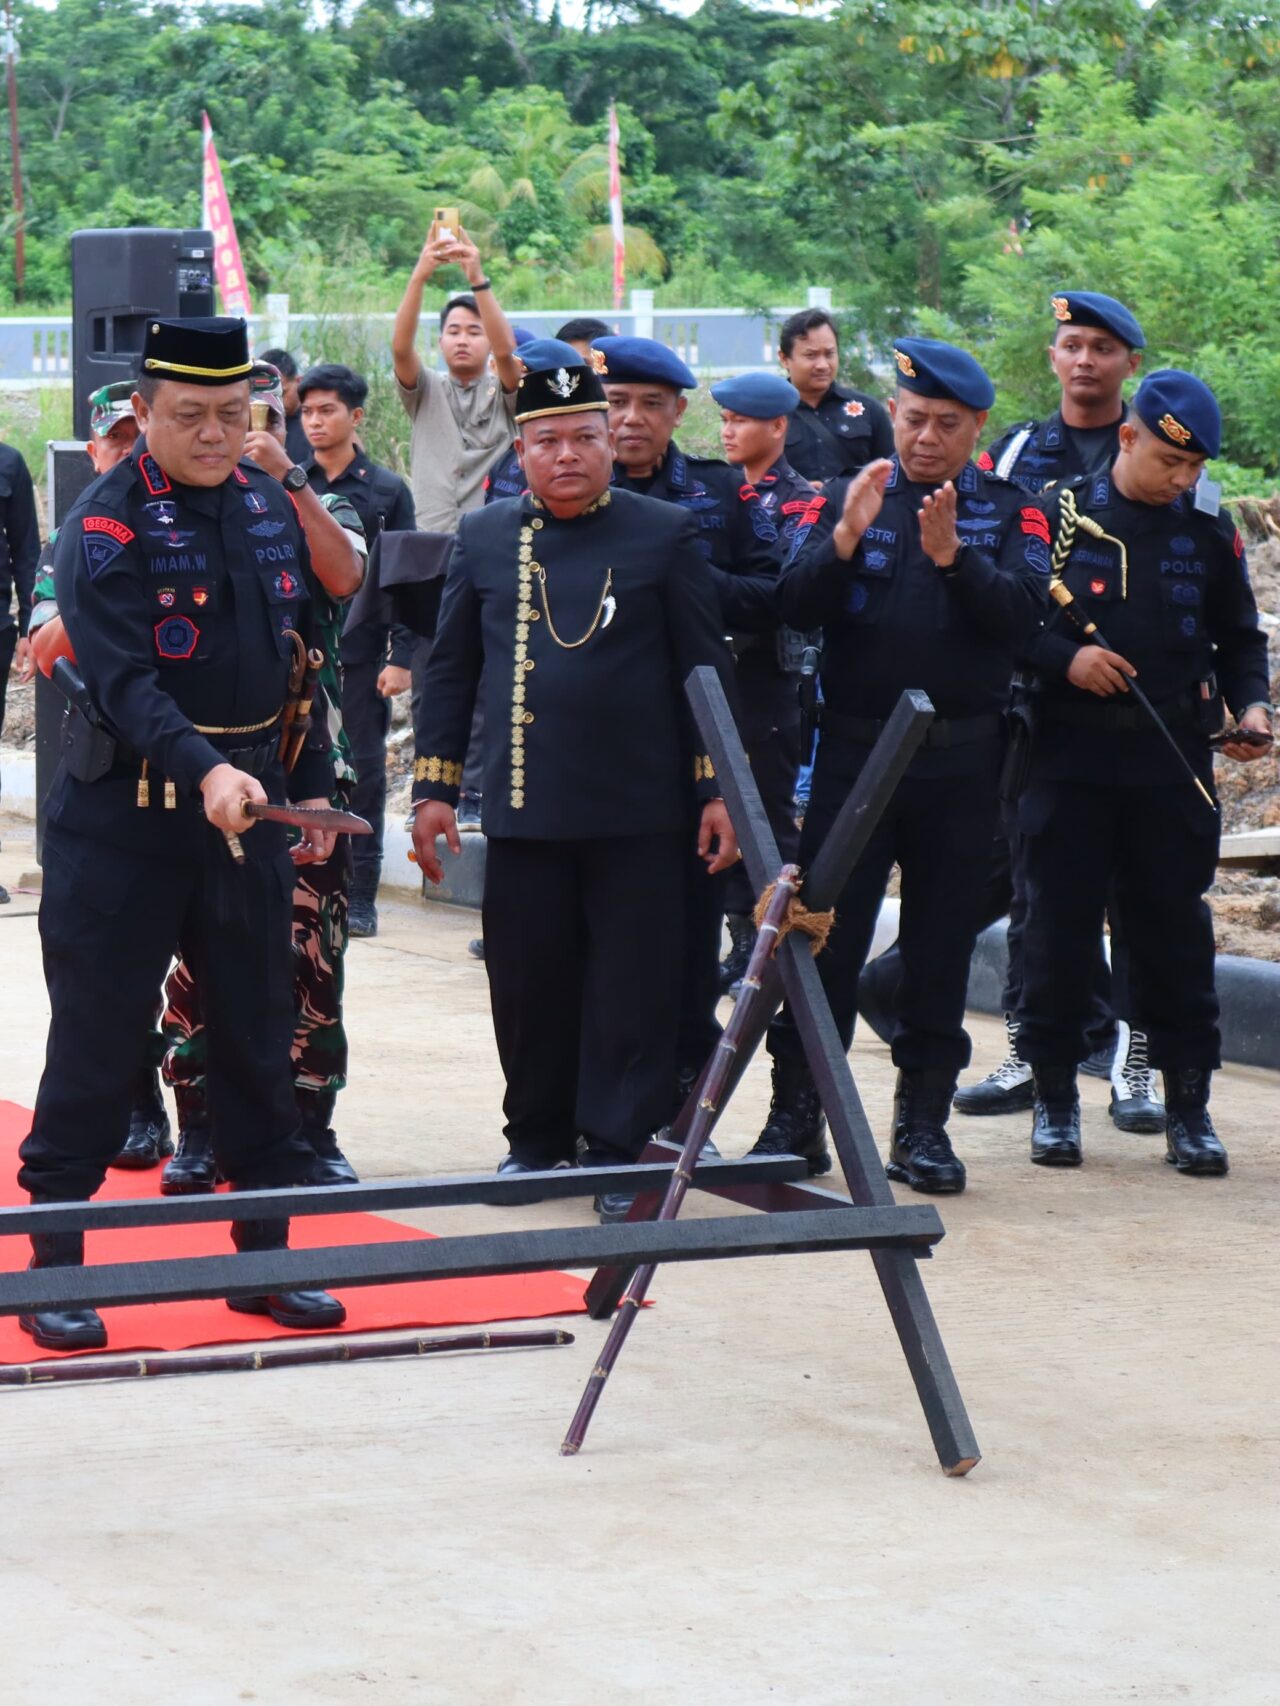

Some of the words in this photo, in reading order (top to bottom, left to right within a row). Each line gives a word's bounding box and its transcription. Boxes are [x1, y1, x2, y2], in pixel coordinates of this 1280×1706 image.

[86, 519, 128, 541] GEGANA
[865, 527, 897, 545] STRI
[961, 533, 1001, 549] OLRI
[150, 554, 207, 574] IMAM.W
[255, 543, 297, 565] POLRI
